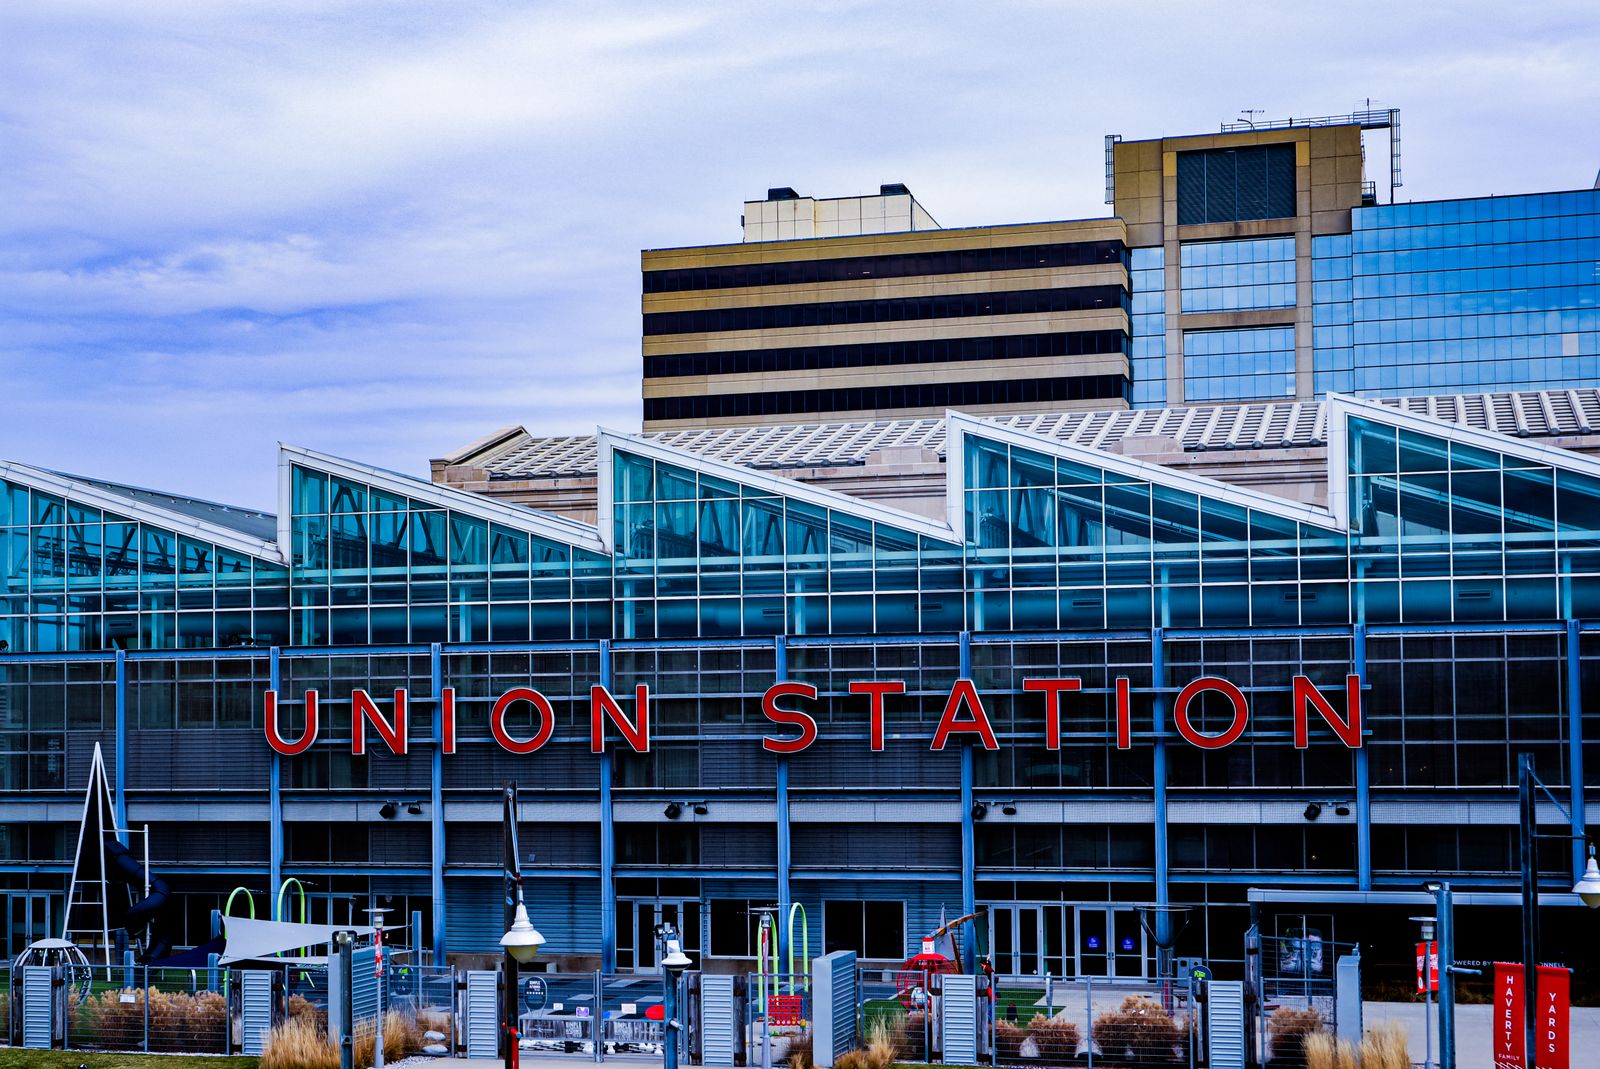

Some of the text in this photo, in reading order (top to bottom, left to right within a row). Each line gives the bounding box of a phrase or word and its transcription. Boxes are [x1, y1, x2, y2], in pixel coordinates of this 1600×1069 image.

[263, 673, 1363, 756] UNION STATION
[1504, 975, 1514, 1052] HAVERTY
[1547, 992, 1557, 1053] YARDS
[1498, 1053, 1520, 1061] FAMILY
